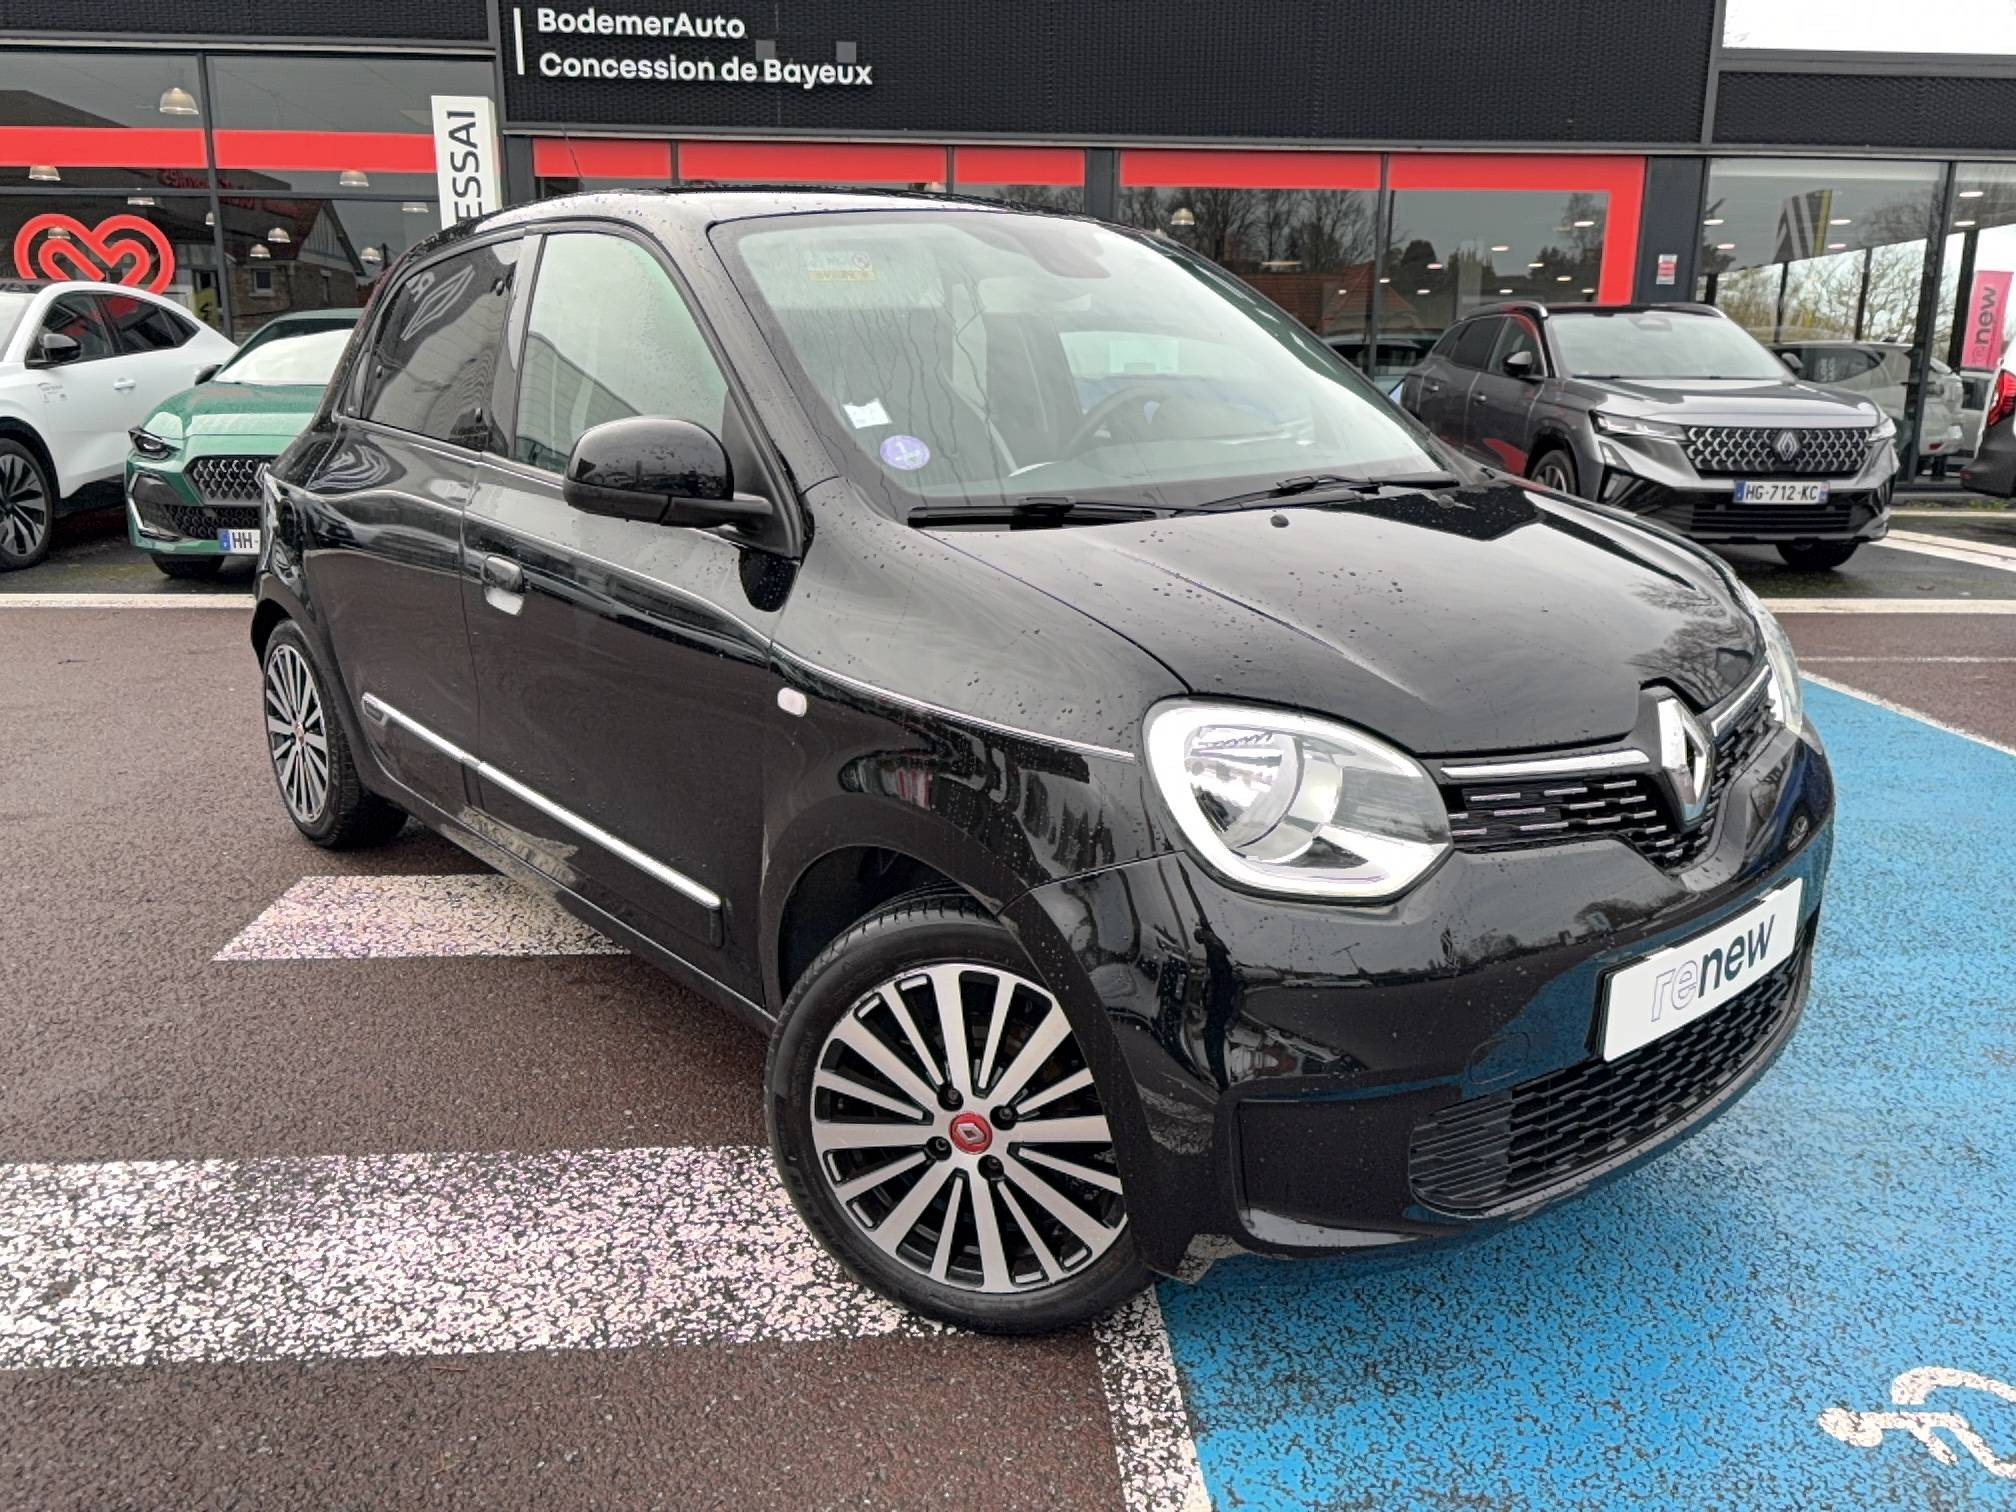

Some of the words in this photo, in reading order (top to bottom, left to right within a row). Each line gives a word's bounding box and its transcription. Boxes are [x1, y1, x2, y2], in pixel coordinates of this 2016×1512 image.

[537, 8, 747, 39] BodemerAuto
[539, 53, 716, 81] Concession
[721, 57, 758, 81] de
[763, 60, 873, 89] Bayeux
[447, 110, 483, 220] ESSAI
[1651, 914, 1776, 1022] renew
